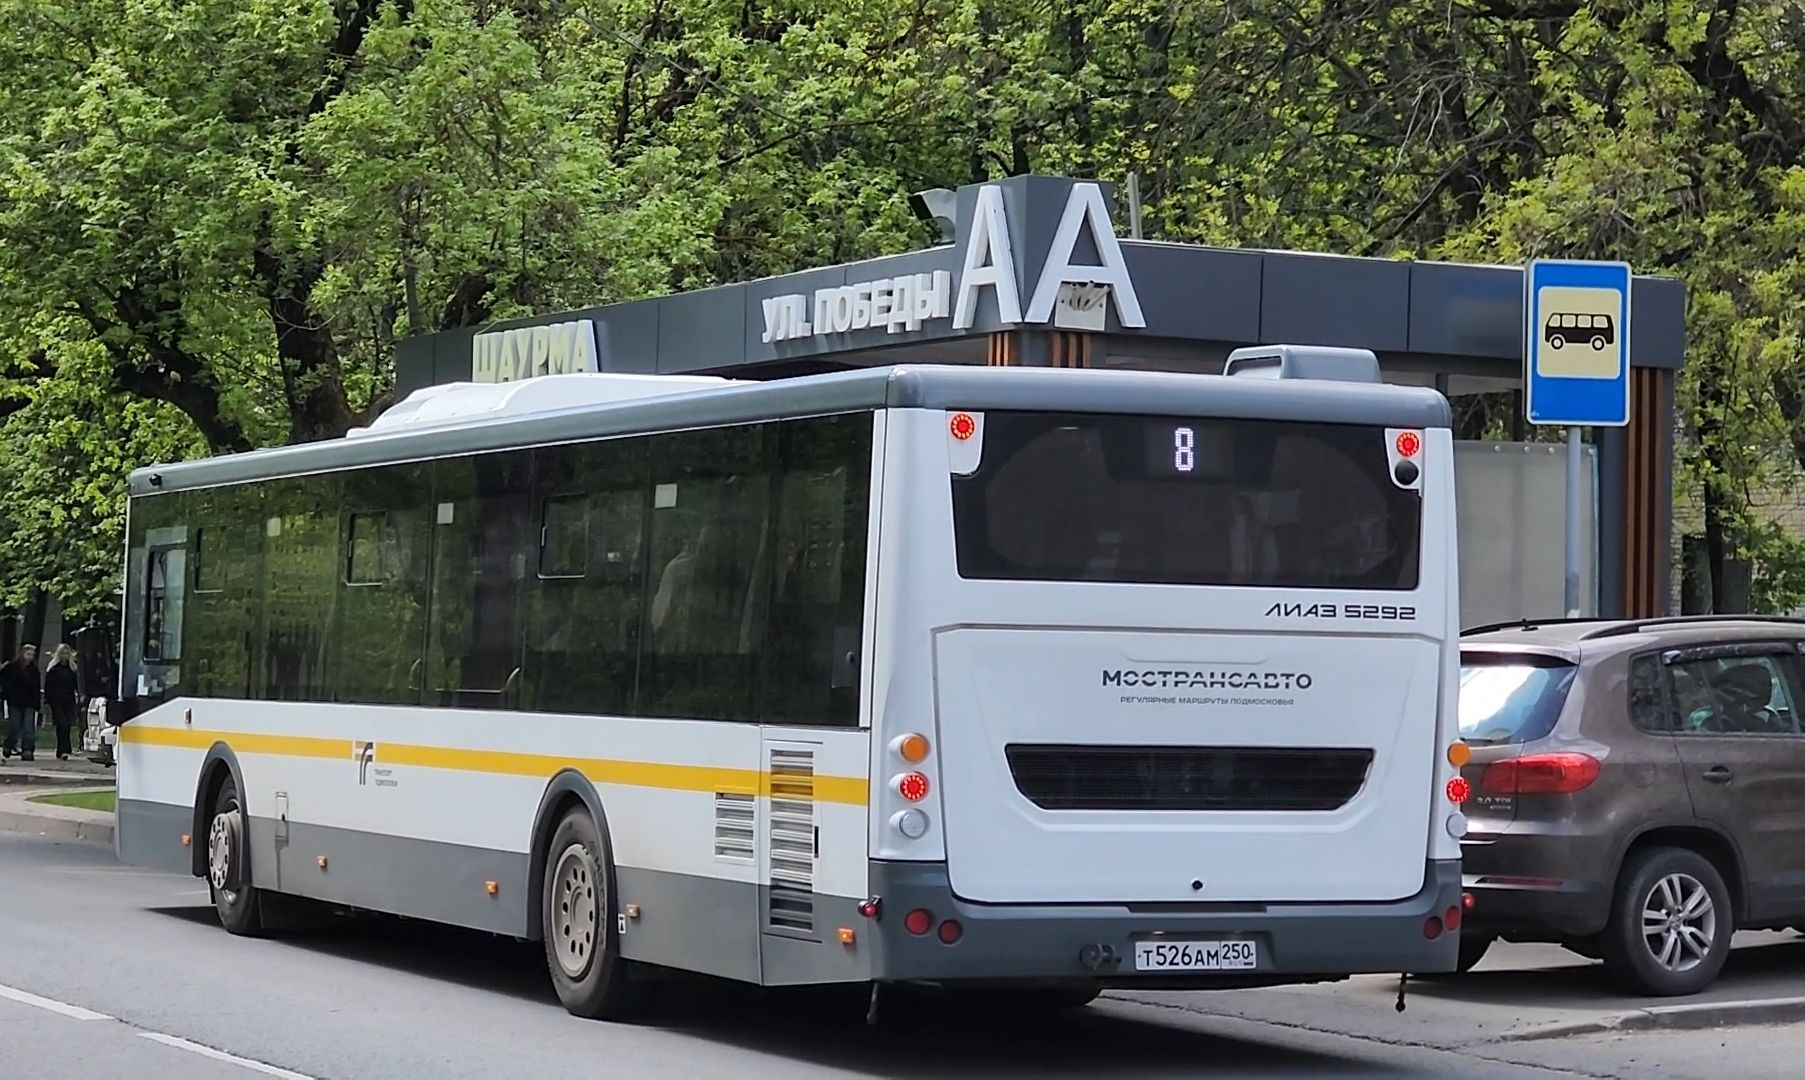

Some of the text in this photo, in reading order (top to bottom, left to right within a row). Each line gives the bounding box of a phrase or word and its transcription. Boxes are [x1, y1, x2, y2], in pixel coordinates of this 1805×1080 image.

[762, 270, 951, 343] УЛ. ПОБЕДЫ
[472, 319, 599, 383] ШАУРМА
[1175, 427, 1194, 471] 8
[1264, 603, 1417, 620] ЛИАЗ 5292
[1101, 669, 1313, 690] МОСТРАНСАВТО
[1120, 696, 1295, 706] РЕГУЛЯРНЫЕ МАРШРУТЫ ПОДМОСКОВЬЯ
[1222, 943, 1251, 960] 250
